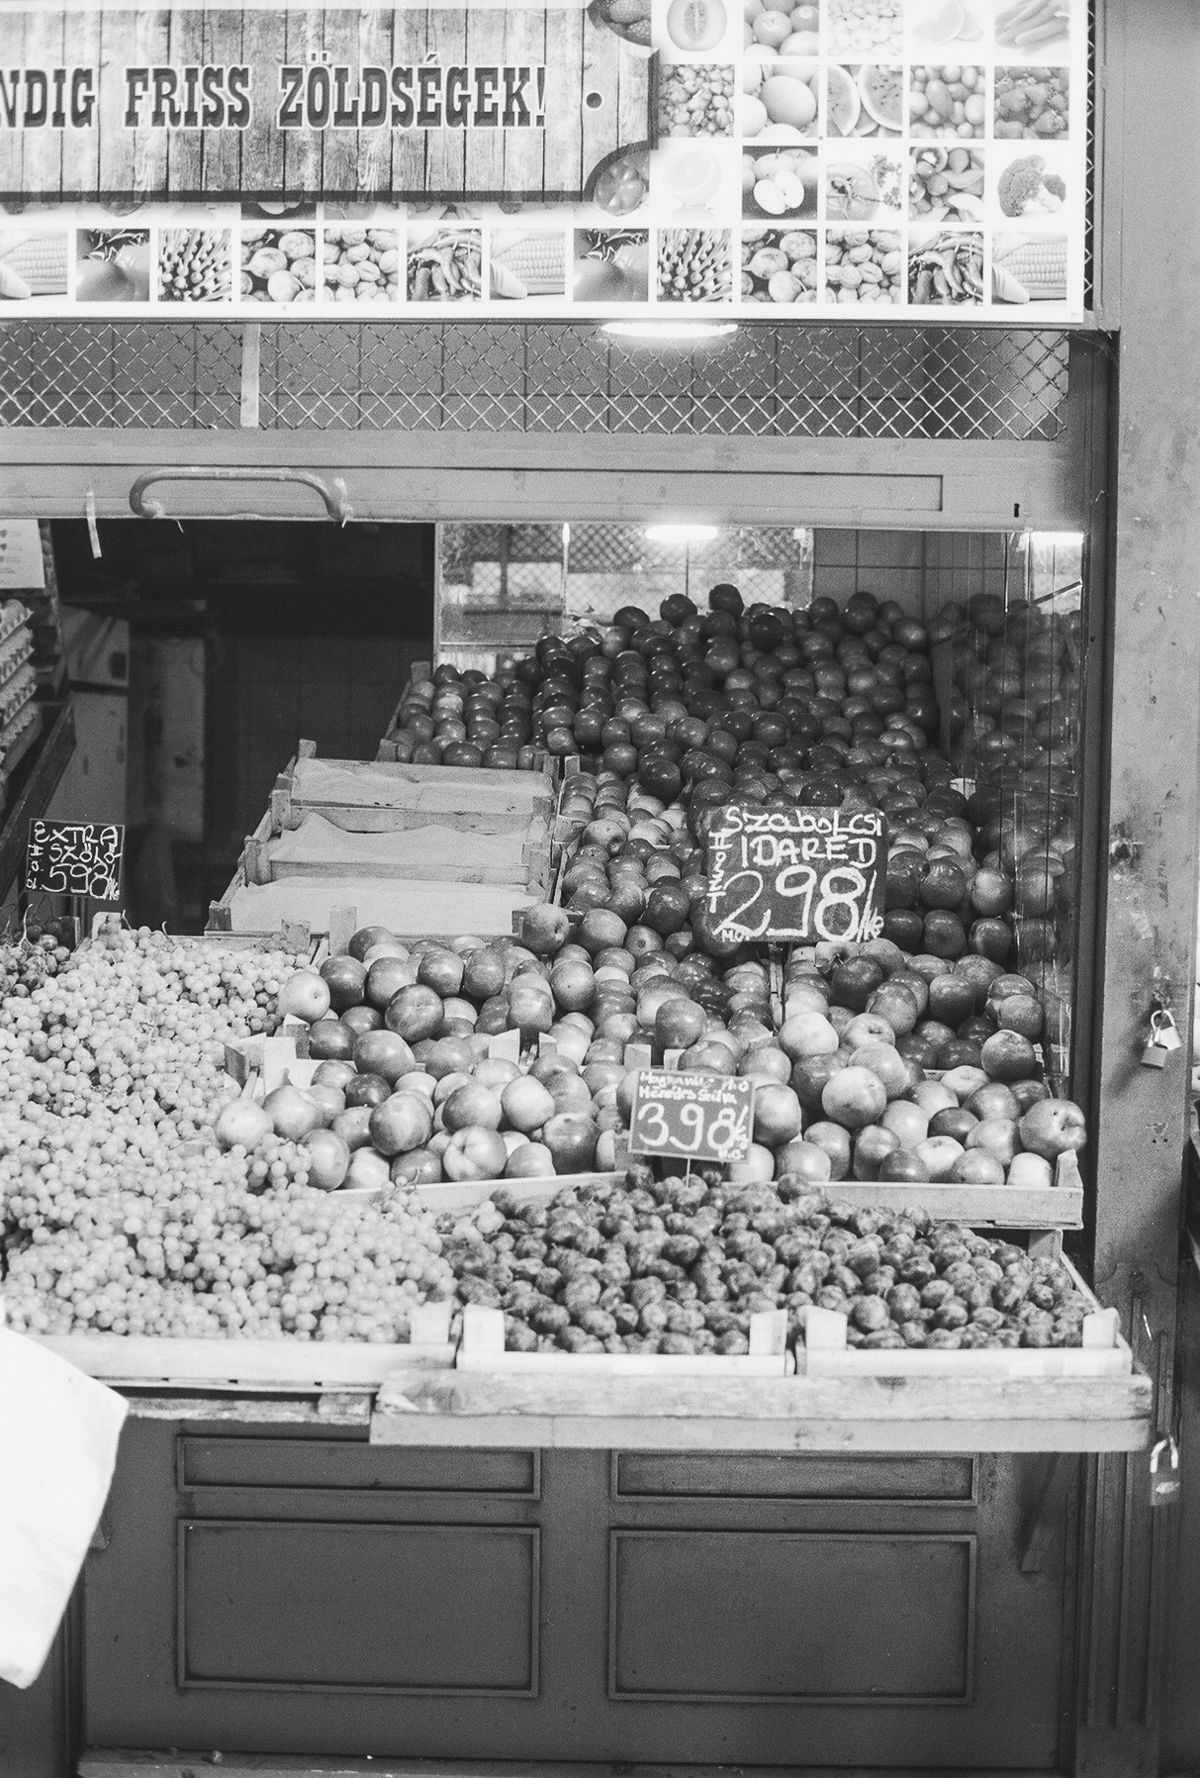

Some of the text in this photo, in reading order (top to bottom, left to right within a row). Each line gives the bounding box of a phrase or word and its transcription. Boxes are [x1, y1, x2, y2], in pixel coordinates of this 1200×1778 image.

[124, 67, 250, 127] FRISS
[278, 52, 547, 128] ZÖLDSÉGEK!
[34, 821, 118, 847] EXTRA
[741, 834, 876, 869] IDARED
